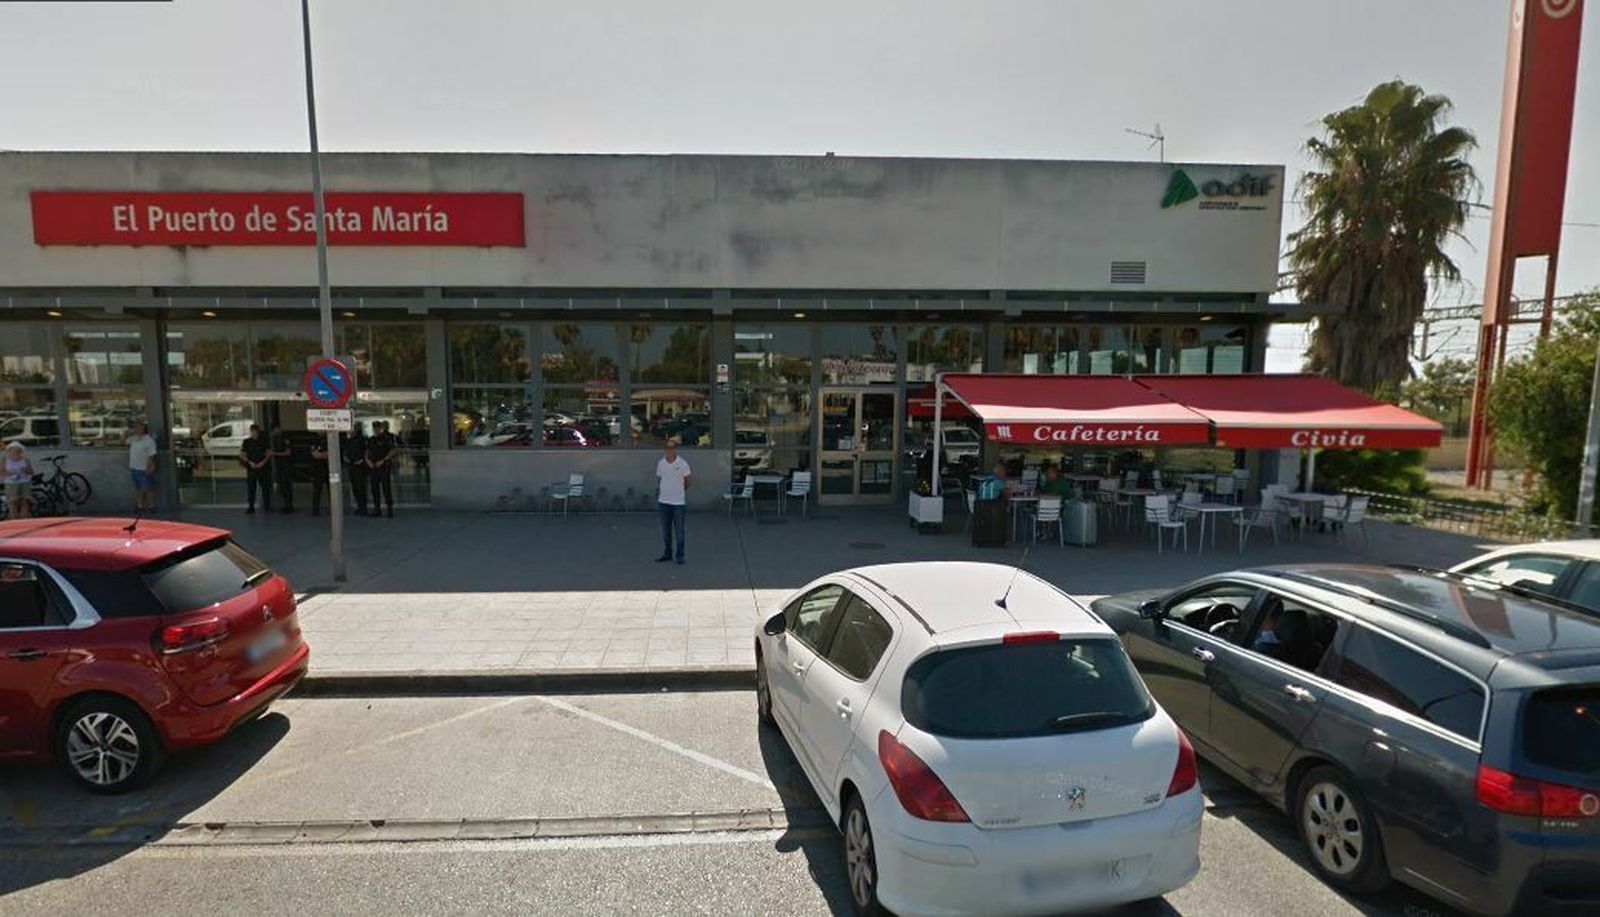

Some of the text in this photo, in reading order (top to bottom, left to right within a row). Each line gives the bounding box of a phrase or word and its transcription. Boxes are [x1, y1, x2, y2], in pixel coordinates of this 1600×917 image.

[112, 204, 449, 232] El Puerto de Santa María
[1033, 424, 1161, 442] Cafetería
[1291, 430, 1366, 447] Civia
